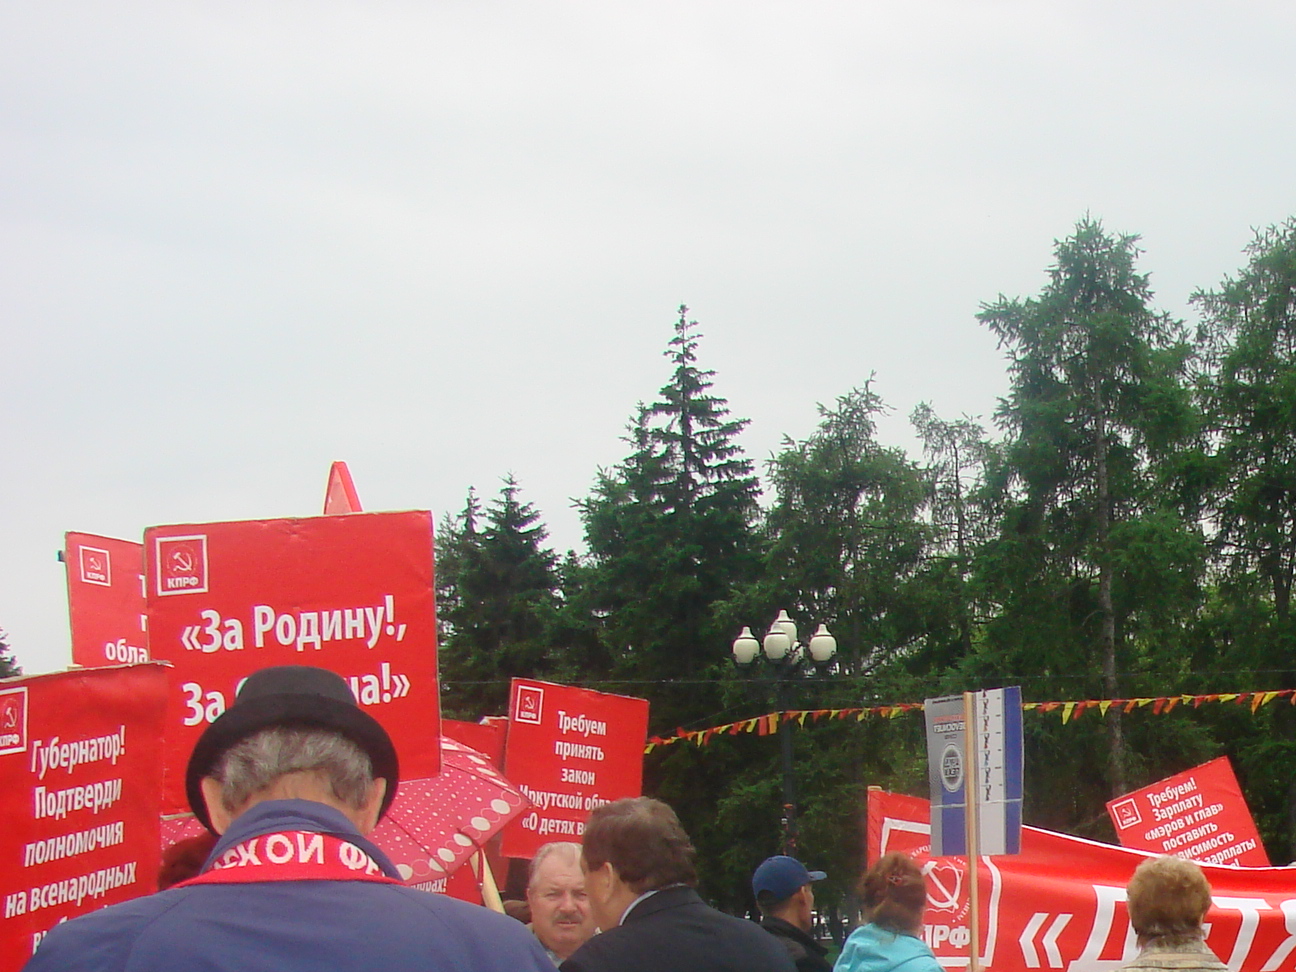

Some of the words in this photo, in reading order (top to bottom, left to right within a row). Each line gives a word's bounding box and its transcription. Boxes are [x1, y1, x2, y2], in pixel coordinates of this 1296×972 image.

[86, 571, 106, 581] КПРФ
[167, 576, 199, 588] КПРФ
[181, 609, 244, 653] «За
[253, 594, 407, 652] Родину!,
[105, 638, 148, 662] обла
[182, 682, 225, 726] За
[558, 711, 606, 737] Требуем
[31, 725, 126, 780] Губернатор!
[555, 741, 605, 761] принять
[561, 768, 595, 785] закон
[34, 778, 122, 820] Подтверди
[519, 785, 582, 812] Иркутской
[1146, 777, 1197, 808] Требуем!
[1144, 818, 1185, 841] «мэров
[1186, 815, 1195, 826] и
[1195, 802, 1224, 824] глав»
[1152, 793, 1203, 822] Зарплату
[522, 812, 538, 831] «О
[539, 817, 575, 835] детях
[1162, 822, 1218, 851] поставить
[24, 821, 124, 867] полномочия
[1177, 832, 1234, 860] висимость
[1204, 838, 1257, 865] зарплаты
[5, 891, 26, 919] на
[30, 861, 137, 912] всенародных
[921, 924, 971, 949] ПРФ
